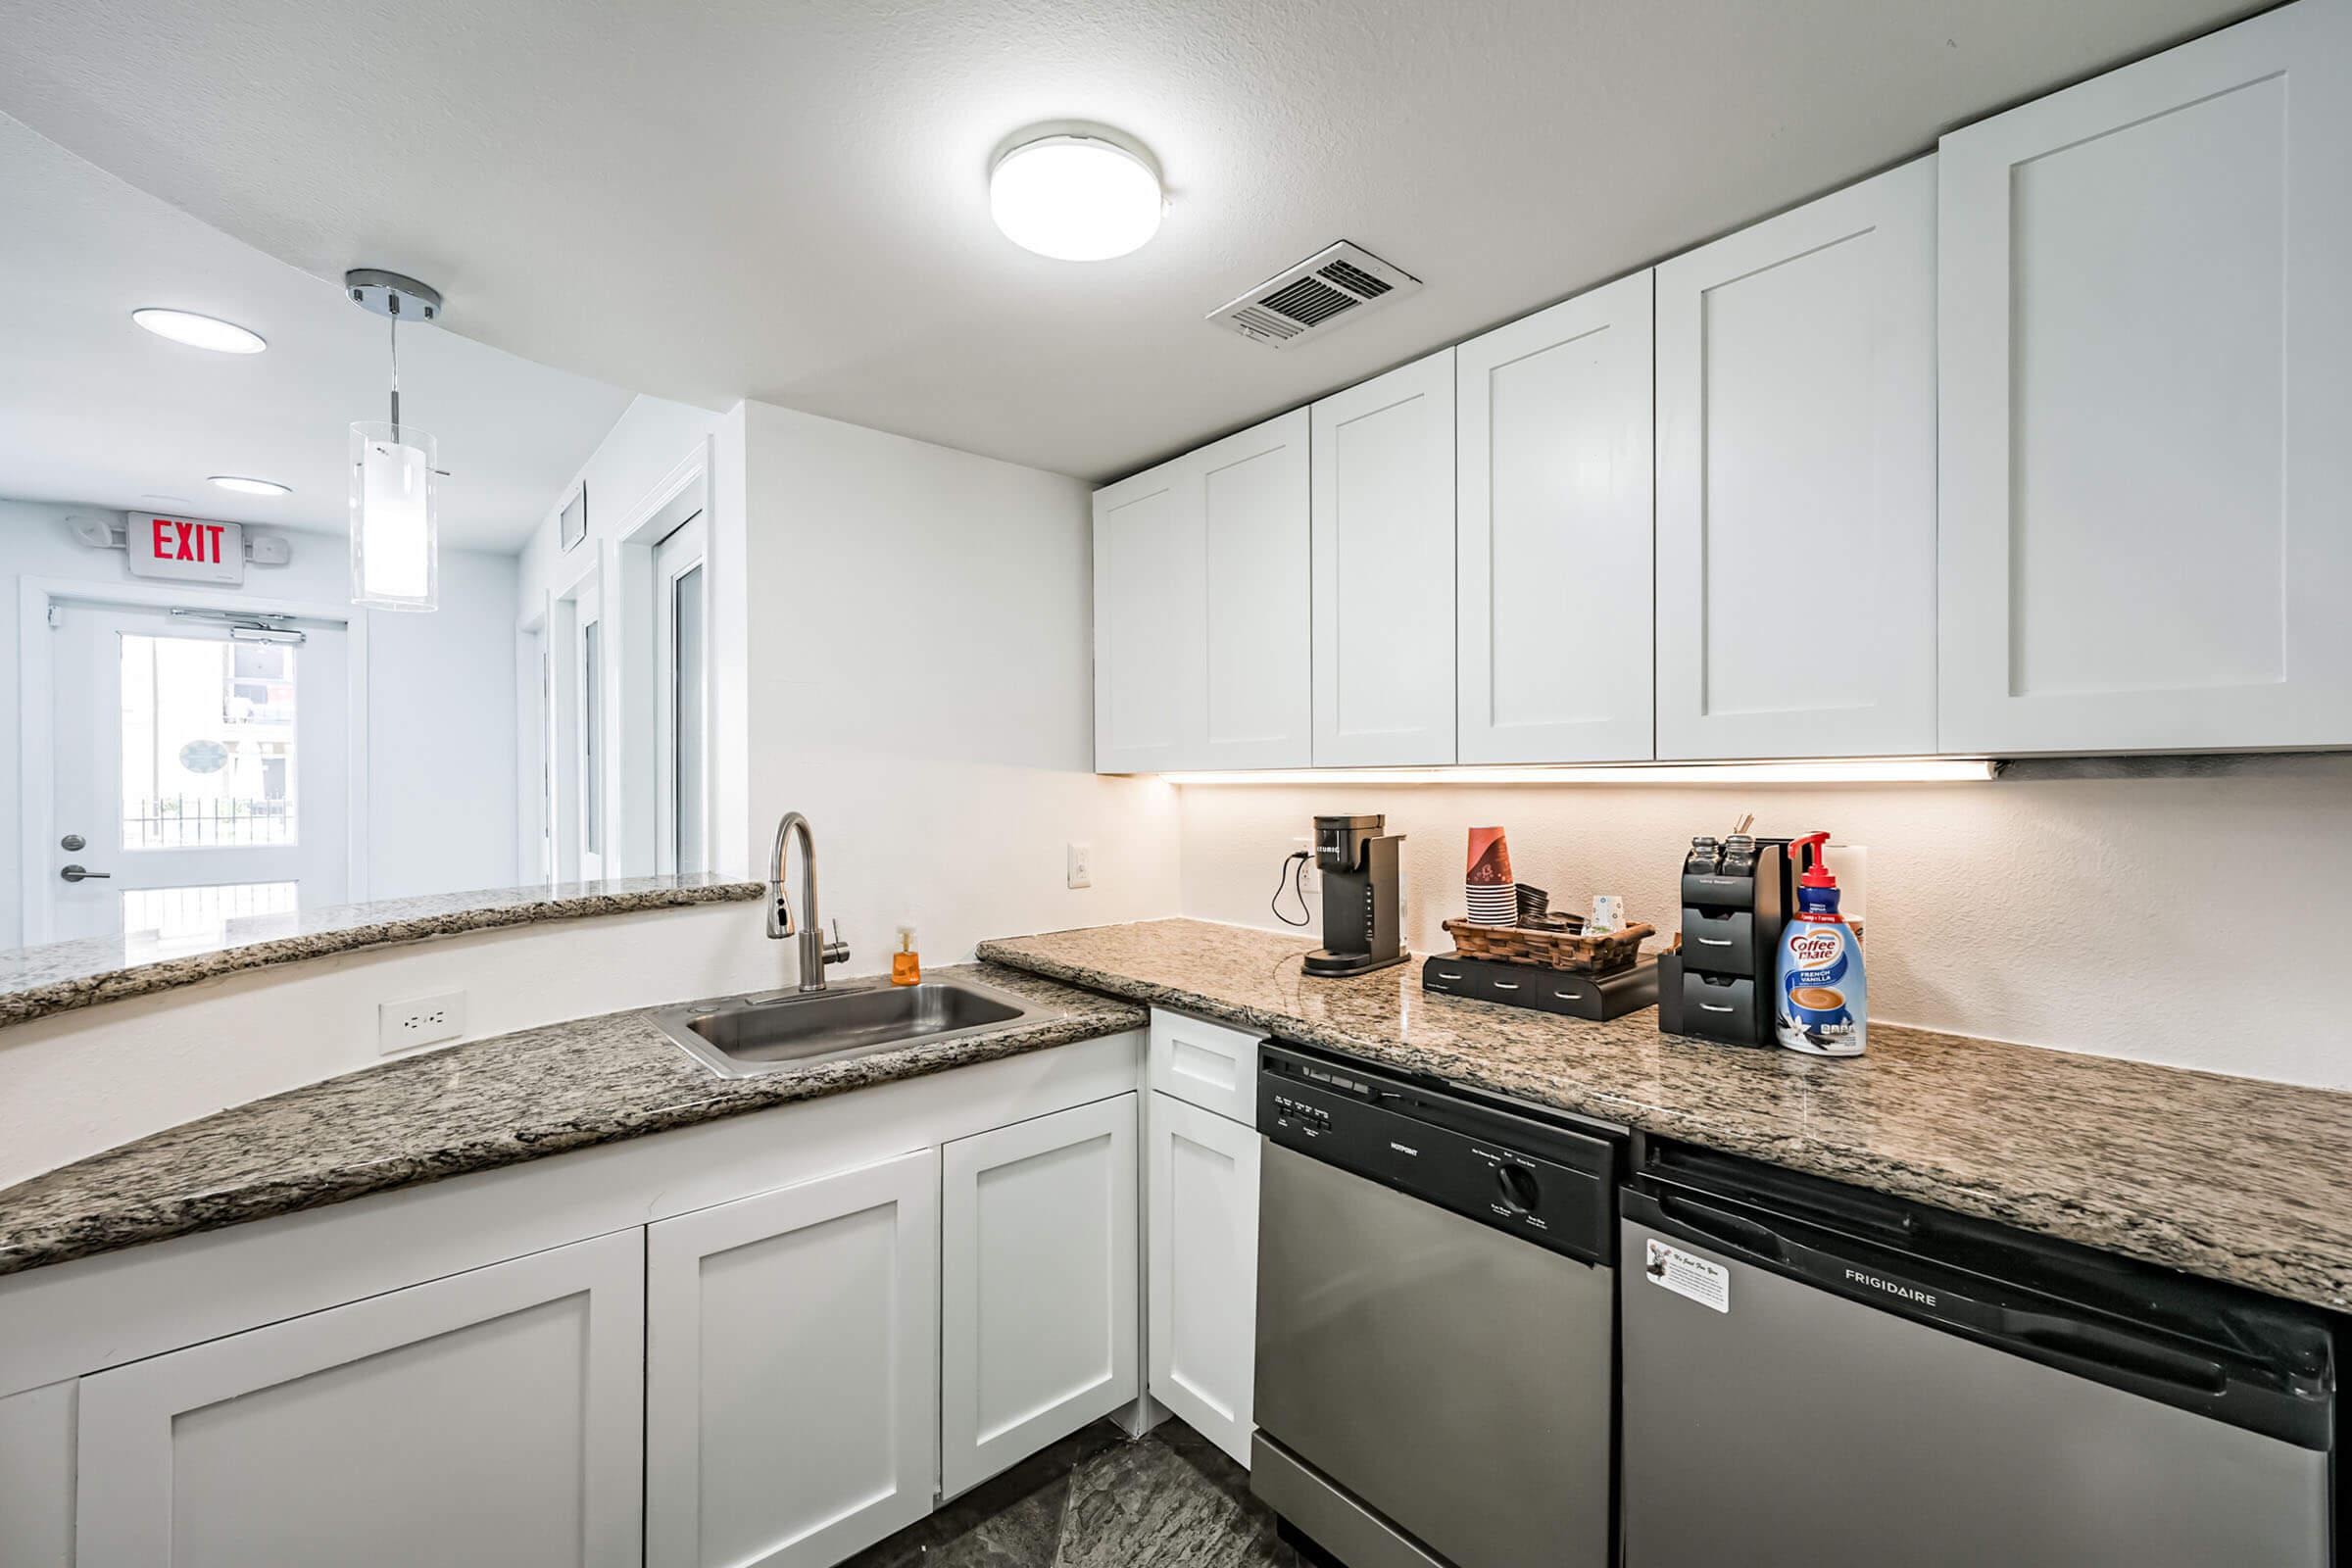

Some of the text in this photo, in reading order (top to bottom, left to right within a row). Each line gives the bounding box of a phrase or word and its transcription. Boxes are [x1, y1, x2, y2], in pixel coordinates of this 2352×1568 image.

[153, 519, 225, 564] EXIT
[1790, 935, 1836, 953] Coffee
[1798, 950, 1834, 960] mate
[1845, 1269, 1937, 1307] FRIGIDAIRE
